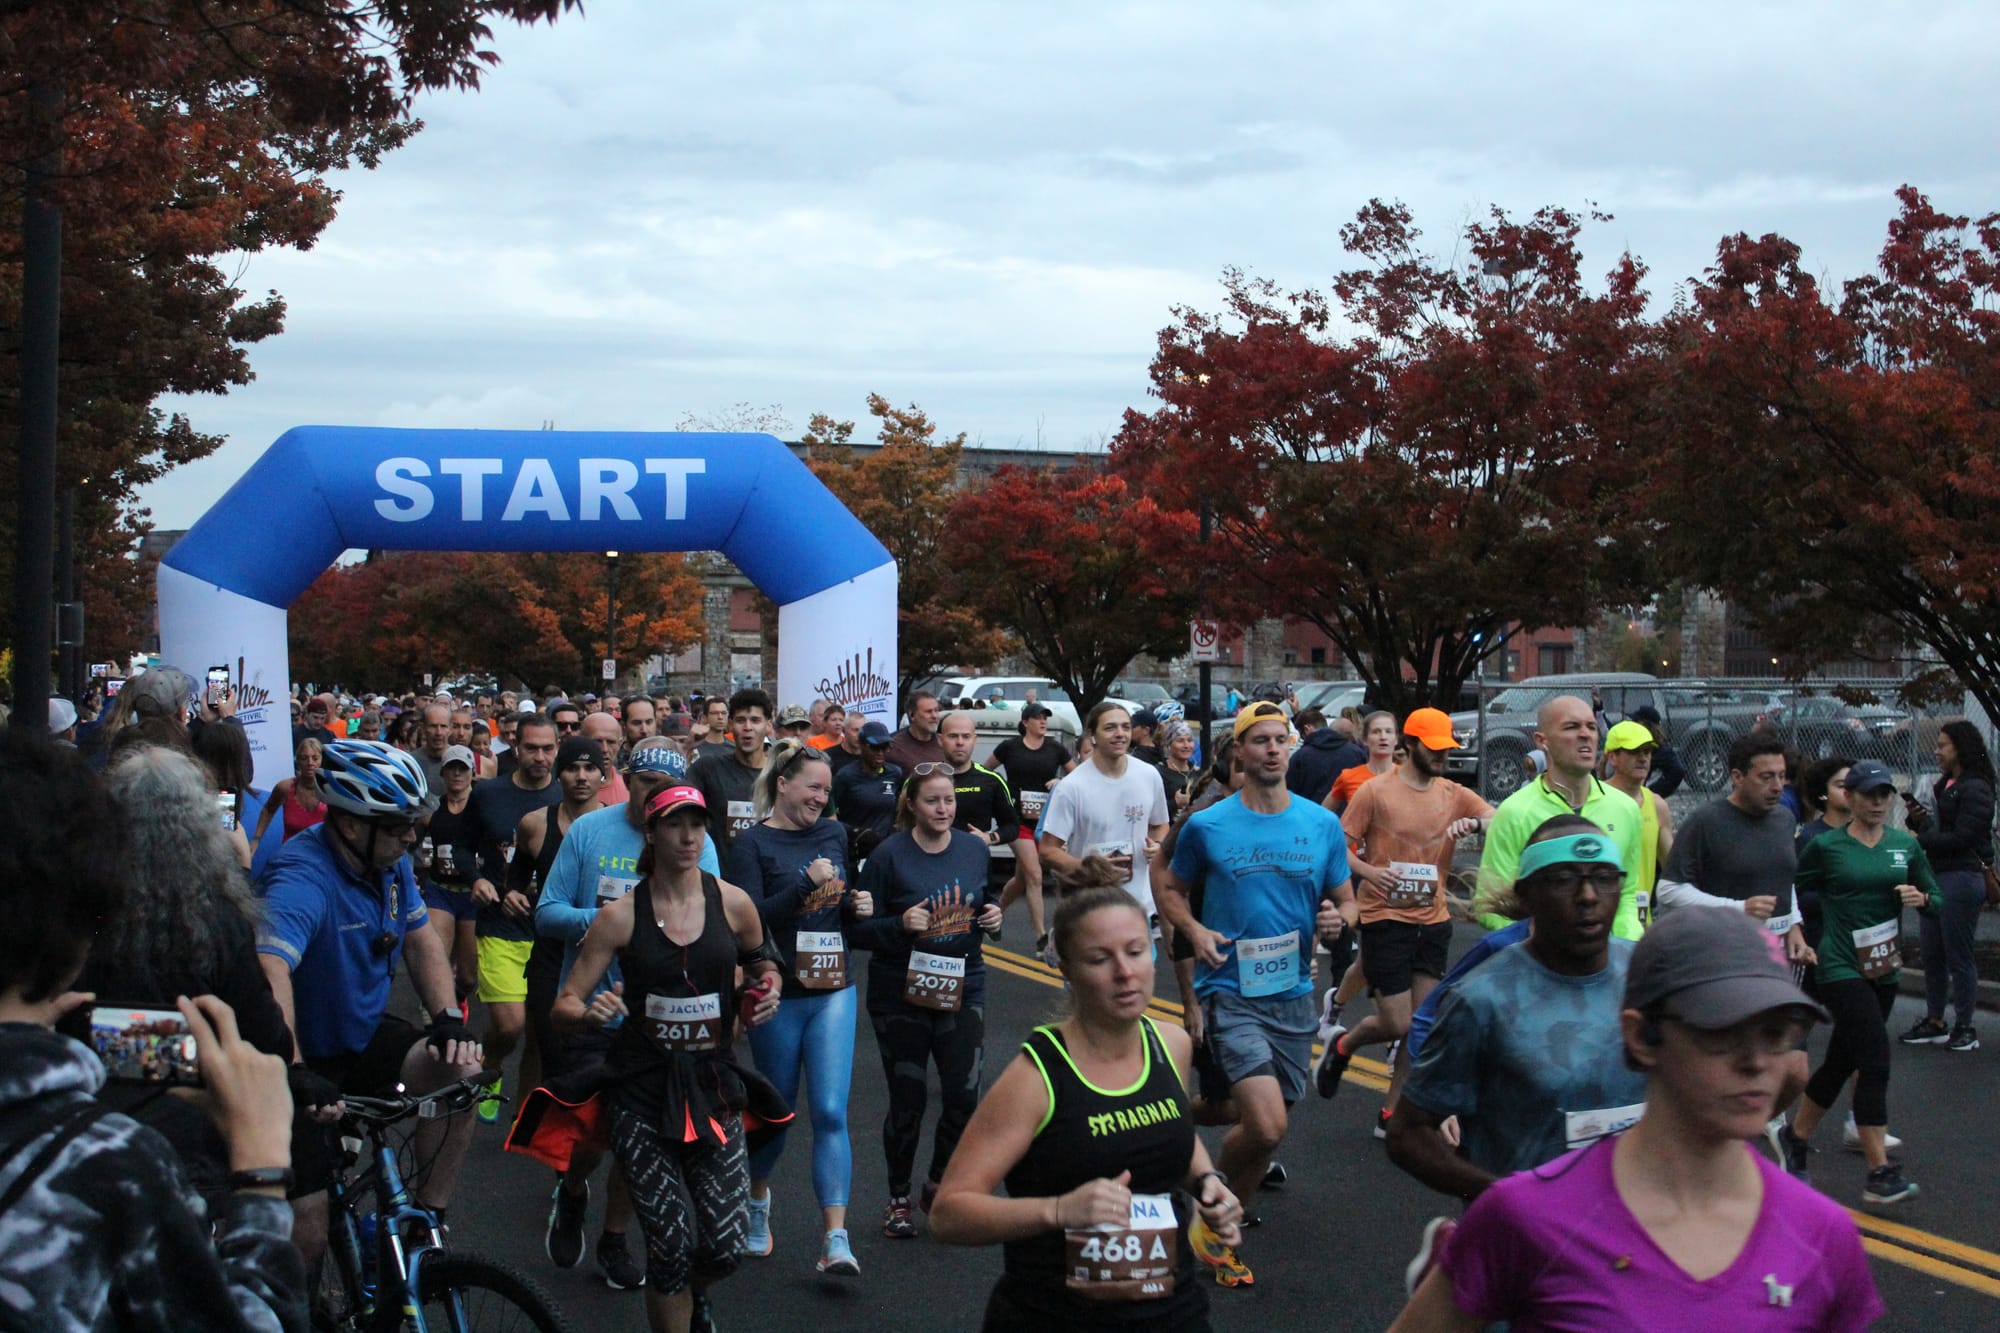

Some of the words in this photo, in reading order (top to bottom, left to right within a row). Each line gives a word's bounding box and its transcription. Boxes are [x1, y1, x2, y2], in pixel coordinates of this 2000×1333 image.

[374, 457, 706, 522] START
[814, 647, 893, 705] Bethlehem
[1248, 847, 1315, 864] Keystone
[1409, 867, 1432, 876] JACK
[1396, 880, 1419, 893] 251
[1421, 882, 1432, 893] A
[1869, 943, 1889, 958] 48
[810, 954, 839, 969] 2171
[929, 959, 962, 971] CATHY
[1253, 957, 1289, 976] 805
[914, 973, 958, 992] 2079
[668, 1001, 715, 1014] JACLYN
[655, 1023, 691, 1040] 261
[695, 1023, 711, 1040] A
[1114, 1097, 1182, 1132] RAGNAR
[1080, 1234, 1143, 1262] 468
[1148, 1233, 1168, 1261] A
